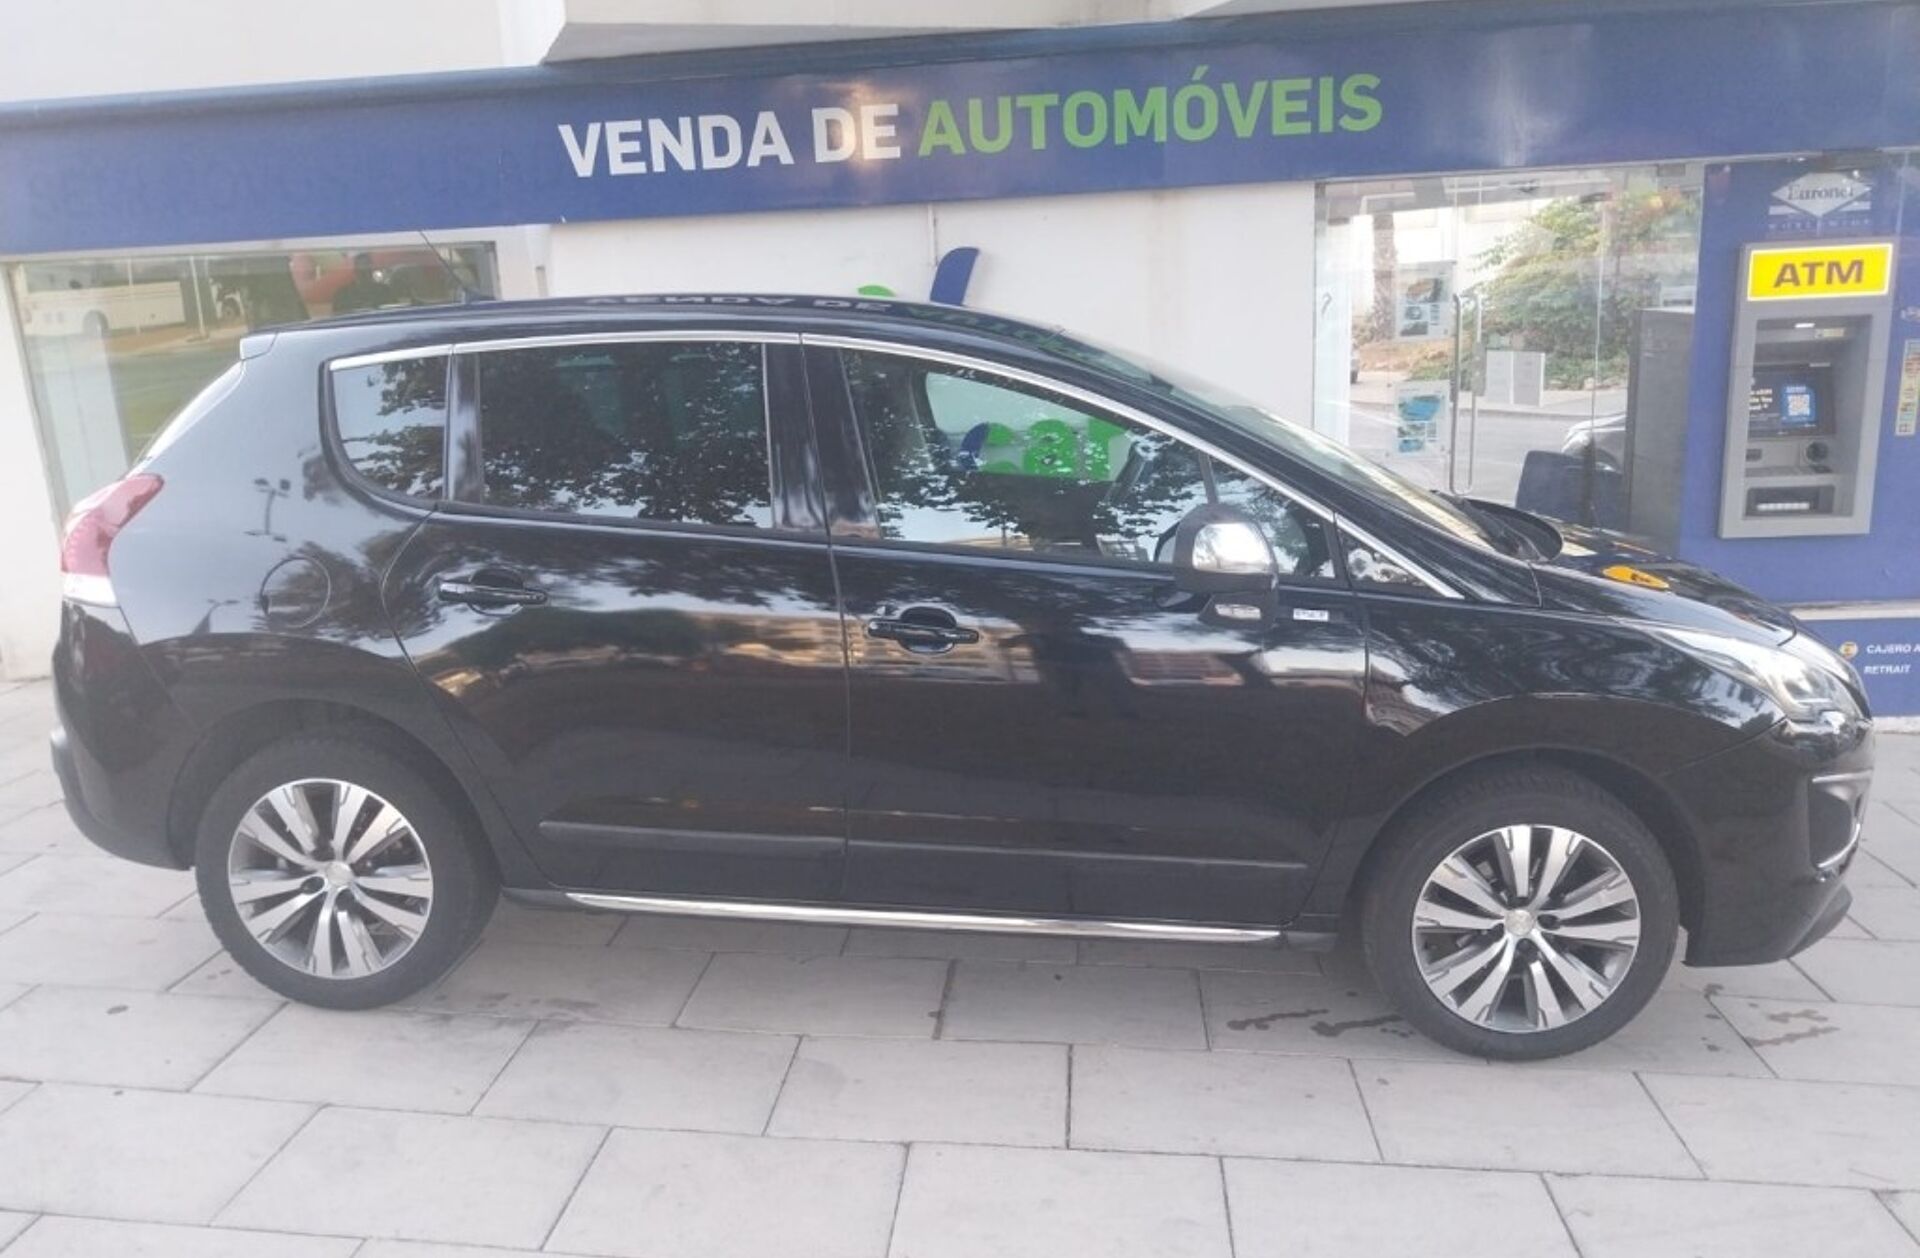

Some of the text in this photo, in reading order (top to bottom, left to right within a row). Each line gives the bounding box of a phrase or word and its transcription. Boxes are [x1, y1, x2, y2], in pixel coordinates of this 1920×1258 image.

[558, 65, 1383, 178] VENDA DE AUTOMÓVEIS
[1773, 259, 1865, 288] ATM
[1866, 643, 1912, 655] CAJERO
[1863, 664, 1911, 675] RETRAIT
